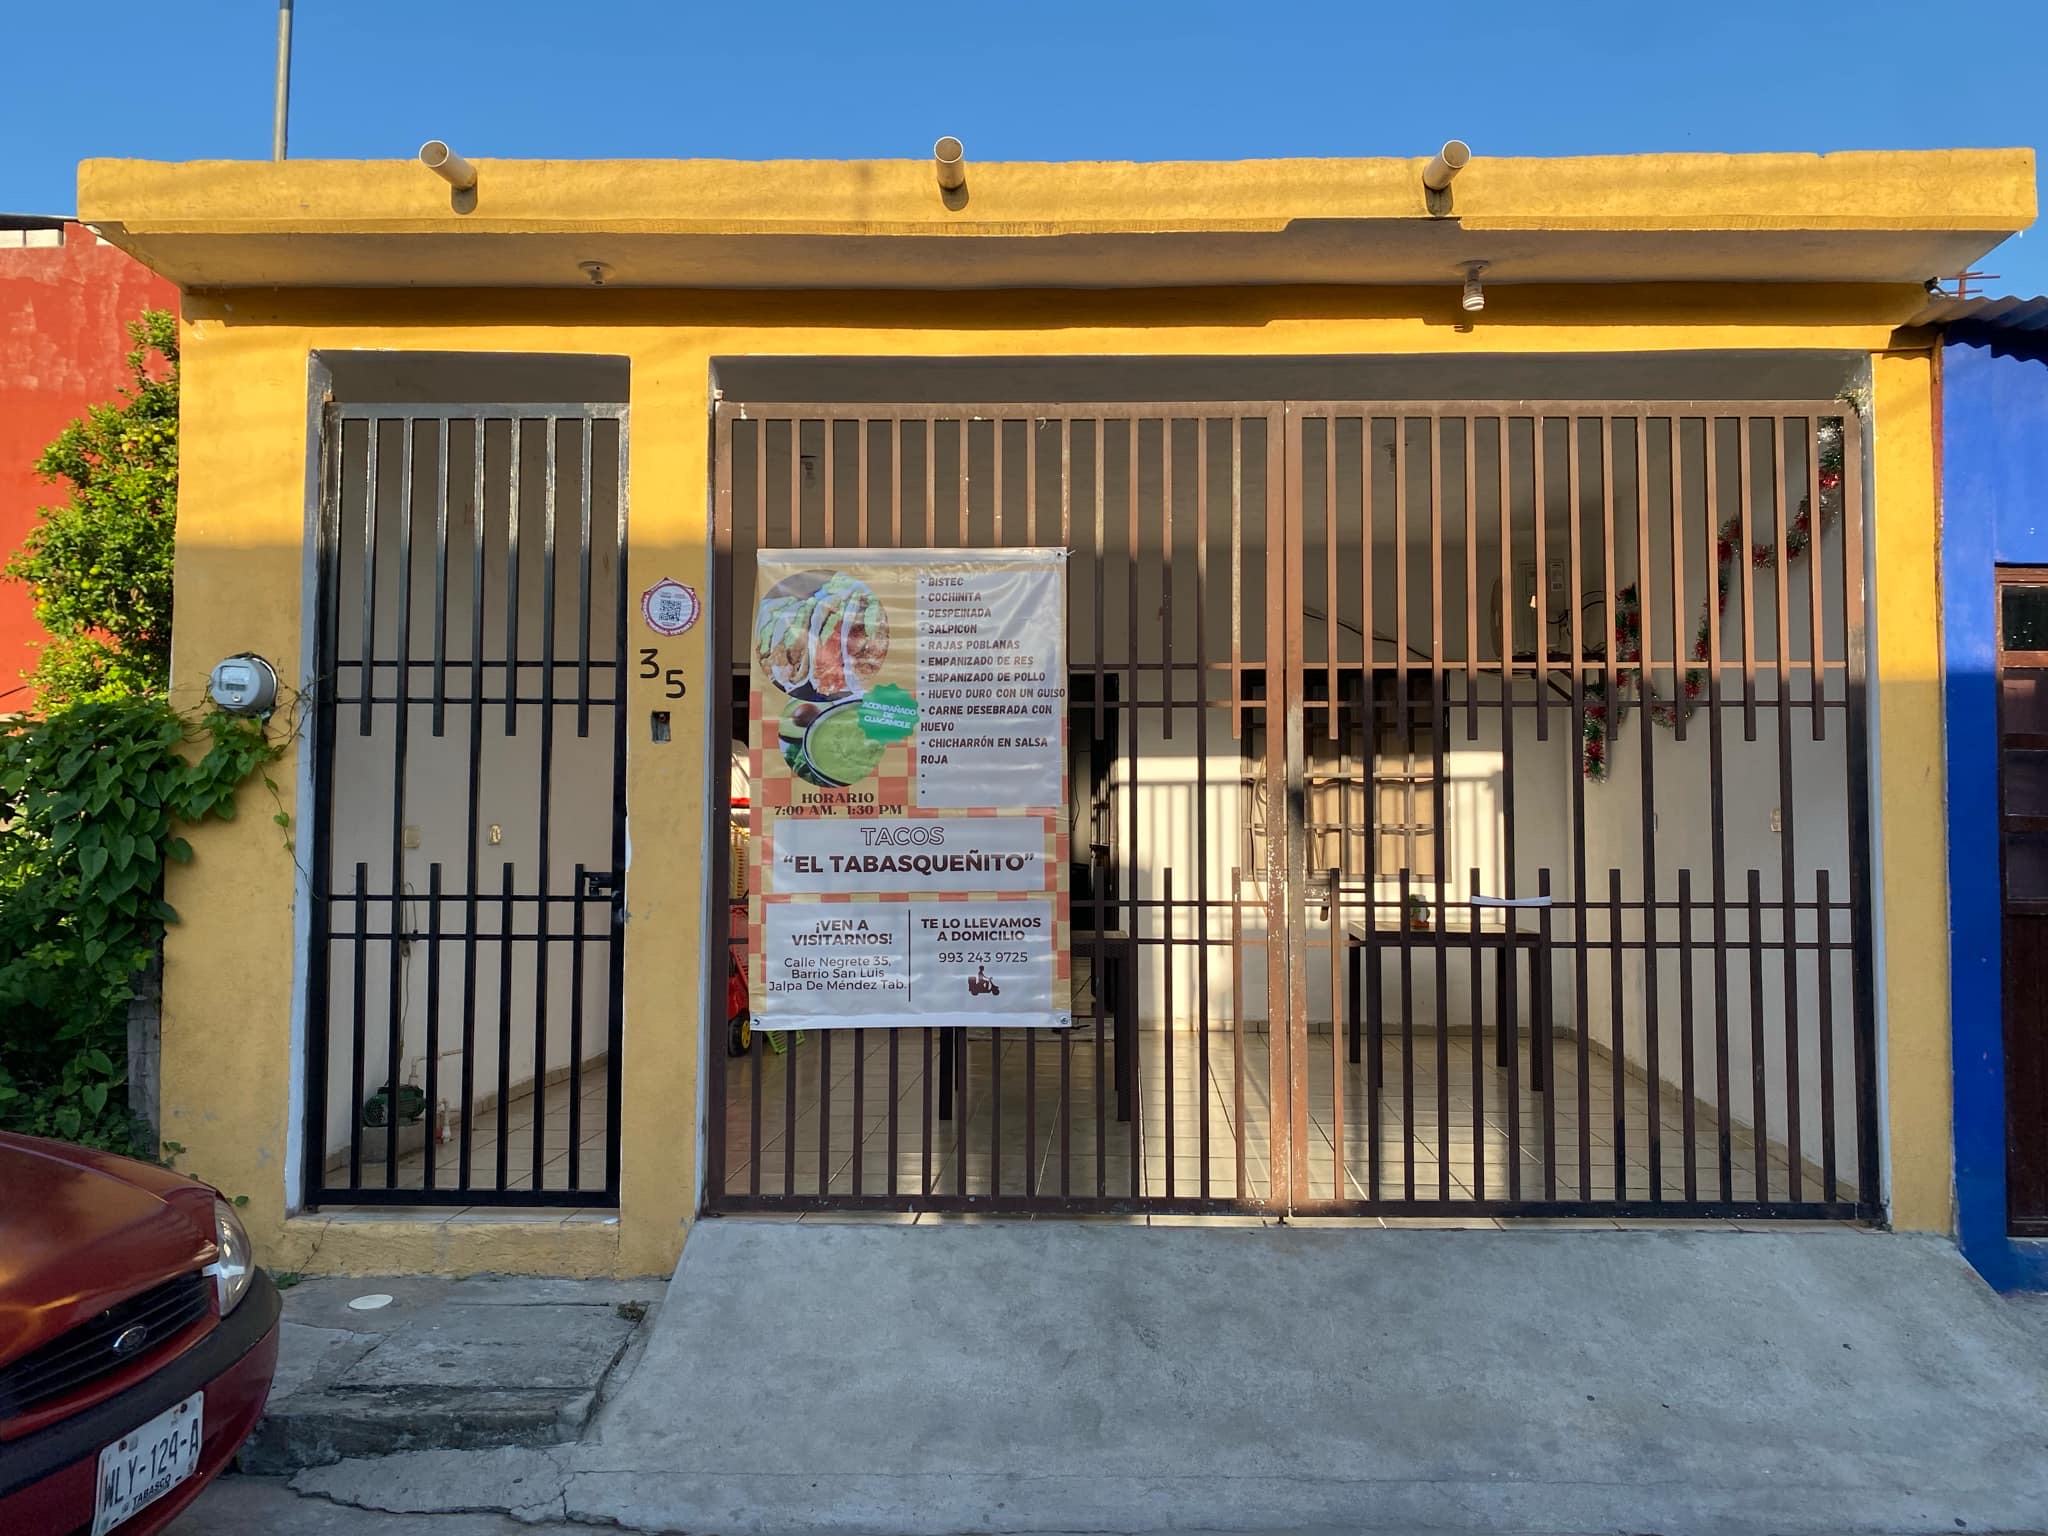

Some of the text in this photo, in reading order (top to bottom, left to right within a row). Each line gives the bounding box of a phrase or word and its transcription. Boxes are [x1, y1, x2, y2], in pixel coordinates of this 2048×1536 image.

[928, 578, 964, 586] BISTEC
[928, 592, 981, 602] COCHINITA
[928, 608, 991, 618] DESPEINADA
[928, 624, 977, 634] SALPICON
[928, 640, 1020, 650] RAJAS POBLANAS
[928, 656, 1033, 666] EMPANIZADO DE RES
[640, 648, 686, 698] 35
[928, 672, 1045, 682] EMPANIZADO DE POLLO
[929, 688, 1065, 698] HUEVO DURO CON UN GUISO
[929, 705, 1052, 715] CARNE DESEBRADA CON
[921, 722, 954, 731] HUEVO
[929, 736, 1048, 748] CHICHARRÓN EN SALSA
[921, 755, 948, 764] ROJA
[802, 793, 874, 803] HORARIO
[775, 805, 902, 815] 7:00 AM. 1:30 PM
[861, 827, 944, 846] TACOS
[816, 920, 868, 934] ¡VEN A
[921, 918, 1041, 929] TE LO LLEVAMOS
[792, 934, 892, 946] VISITARNOS!
[937, 930, 1025, 941] A DOMICILIO
[784, 956, 891, 969] Calle Negrete 35,
[939, 952, 1028, 963] 993 243 9725
[792, 967, 884, 979] Barrio San Luis
[769, 978, 907, 993] Jalpa De Méndez Tab.
[103, 1418, 198, 1512] WLY-124-A
[132, 1474, 171, 1511] TABASCO
